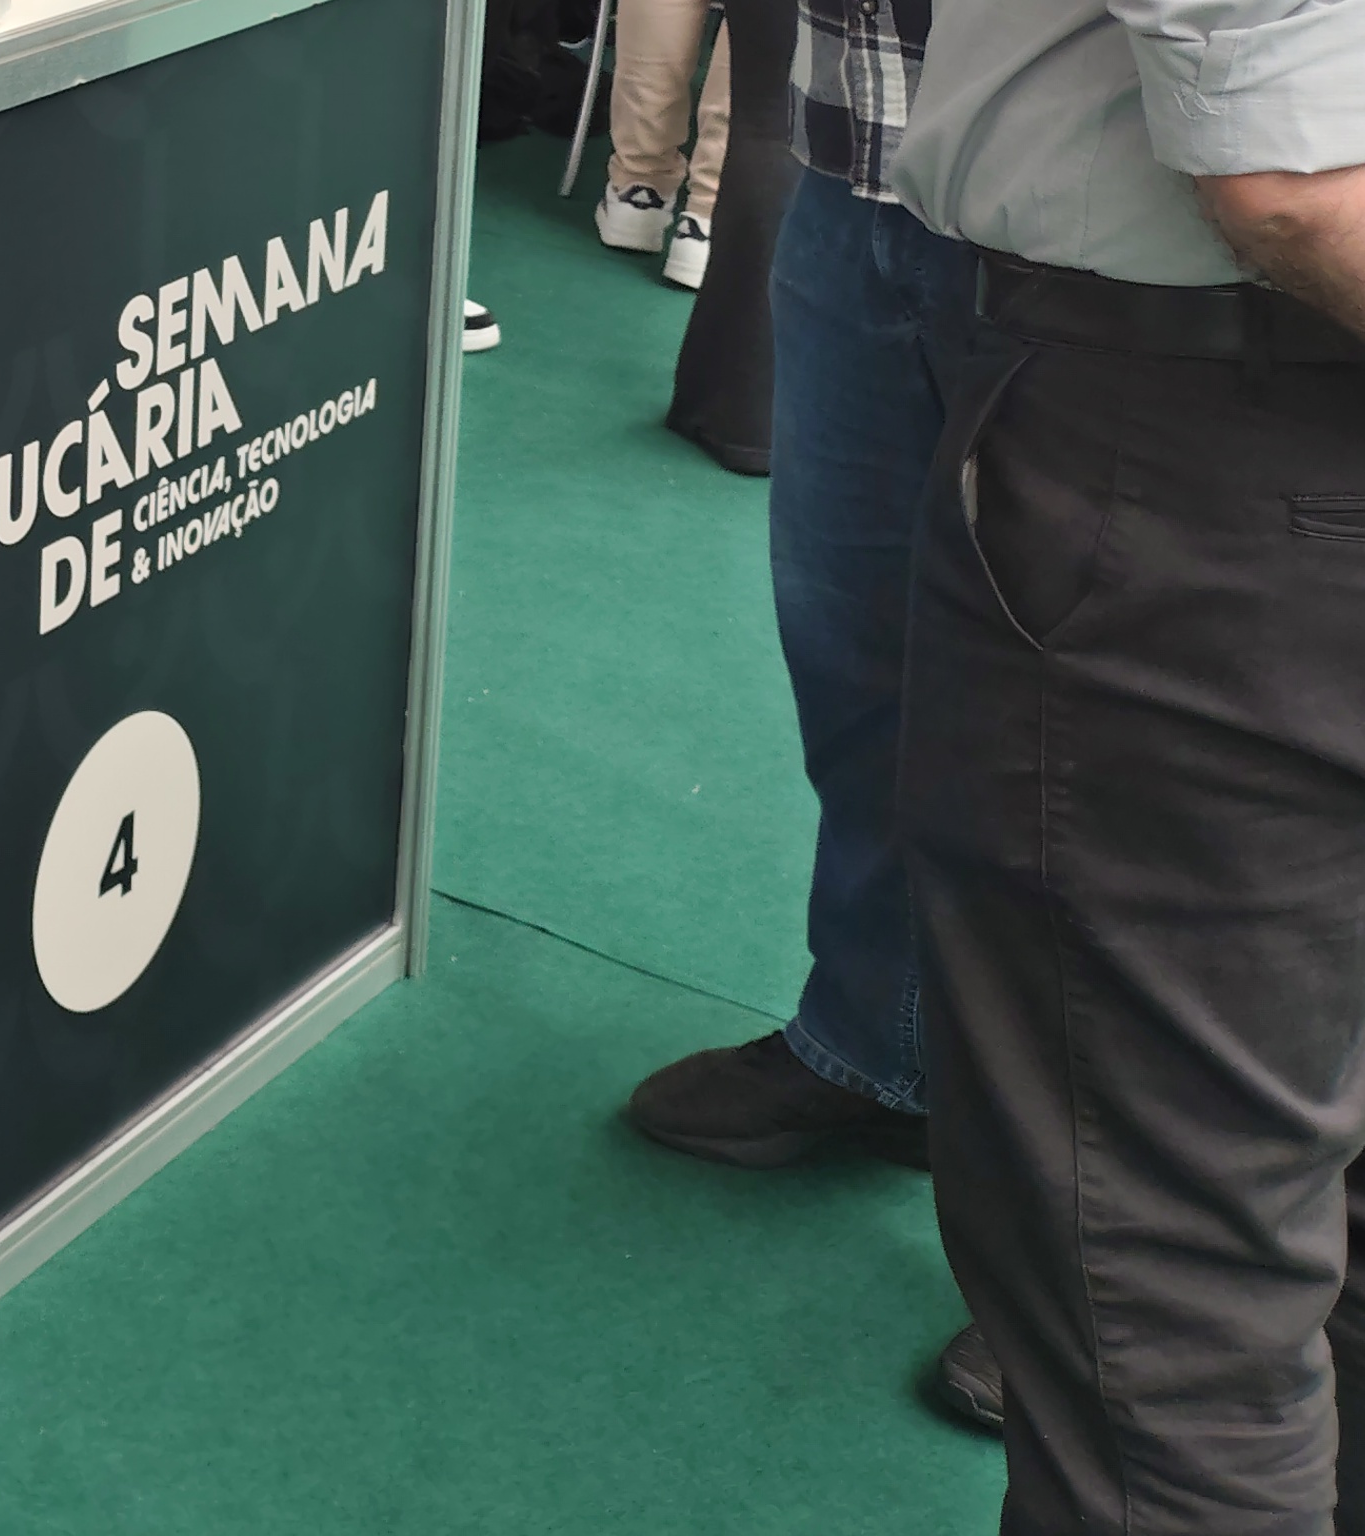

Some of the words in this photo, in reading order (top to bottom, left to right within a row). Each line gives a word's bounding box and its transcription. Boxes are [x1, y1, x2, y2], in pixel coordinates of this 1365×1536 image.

[115, 189, 389, 391] SEMANA
[133, 456, 231, 532] CIÊNCIA,
[236, 378, 376, 479] TECNOLOGIA
[39, 509, 122, 635] DE
[131, 548, 150, 584] &
[157, 478, 279, 570] INOVAÇÃO
[98, 810, 138, 898] 4
